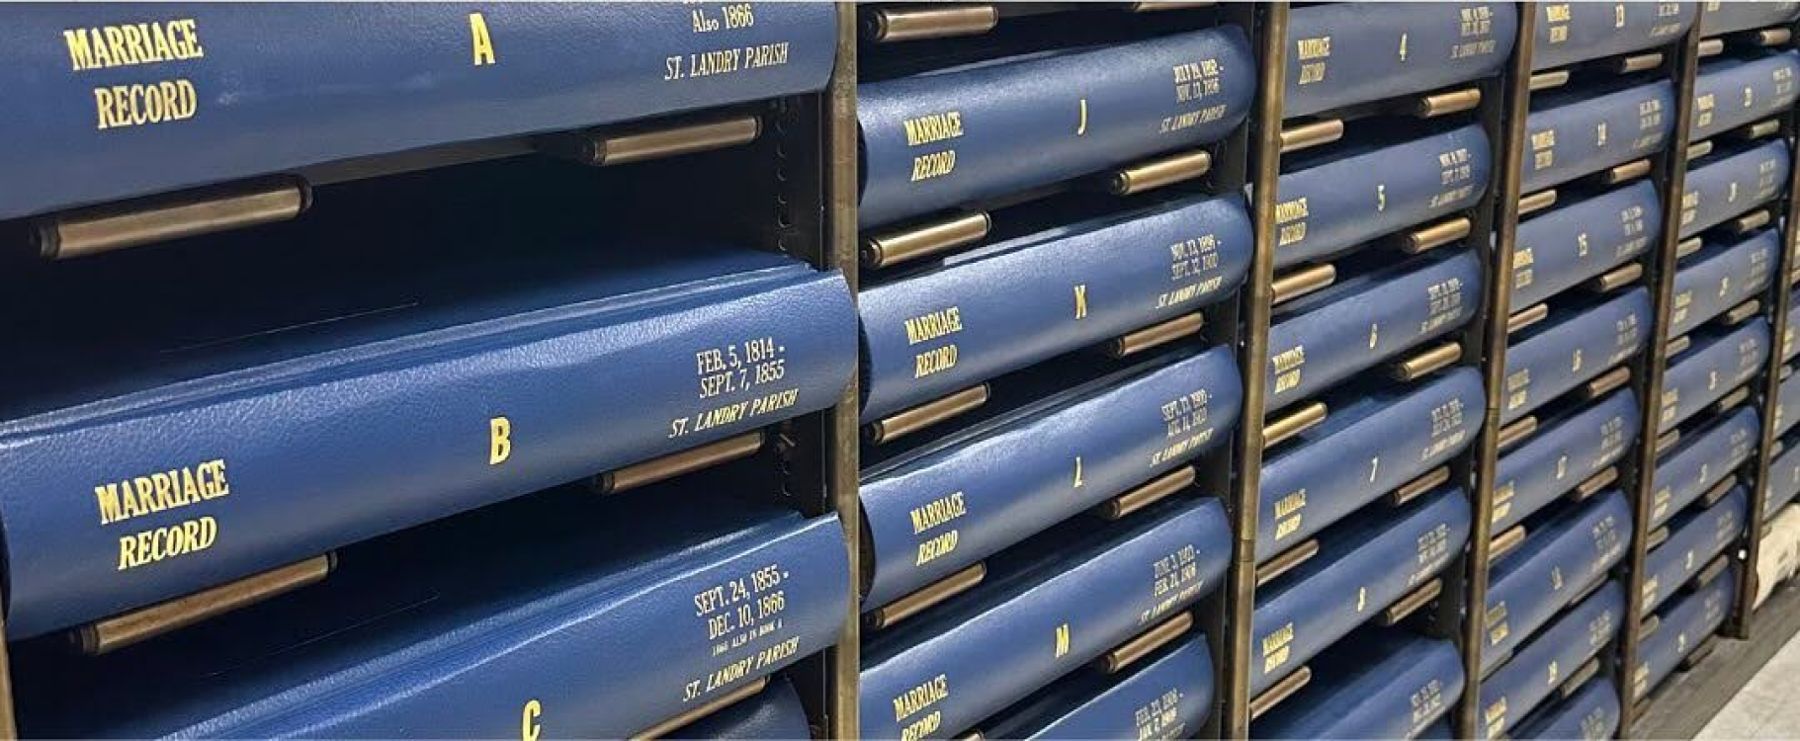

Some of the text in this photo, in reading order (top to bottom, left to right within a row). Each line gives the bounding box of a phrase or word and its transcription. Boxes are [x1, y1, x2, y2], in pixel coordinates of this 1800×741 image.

[692, 3, 754, 33] Also 1866
[63, 19, 204, 71] MARRIAGE
[469, 13, 496, 65] A
[664, 42, 789, 80] ST. LANDRY PARISH
[94, 79, 197, 129] RECORD
[1077, 99, 1087, 135] J
[903, 111, 963, 146] MARRIAGE
[911, 150, 956, 182] RECORD
[1377, 185, 1385, 212] 5
[904, 306, 963, 346] MARRIAGE
[696, 349, 727, 375] FEB.
[728, 344, 742, 369] 5,
[745, 336, 774, 363] 1814
[915, 344, 958, 380] RECORD
[700, 359, 785, 398] SEPT. 7, 1855
[668, 387, 799, 438] ST. LANDRY PARISH
[489, 416, 511, 465] B
[94, 459, 229, 525] MARRIAGE
[1073, 457, 1082, 488] L
[909, 491, 967, 535] MARRIAGE
[118, 516, 217, 570] RECORD
[915, 530, 958, 566] RECORD
[694, 585, 729, 617] SEPT.
[730, 577, 750, 601] 24,
[751, 564, 780, 593] 1855
[708, 590, 785, 640] DEC. 10, 1866
[1055, 623, 1069, 658] M
[683, 635, 800, 703] ST. LANDRY PARISH
[893, 673, 949, 721] MARRIAGE
[523, 700, 540, 741] C
[901, 710, 940, 741] RECORD
